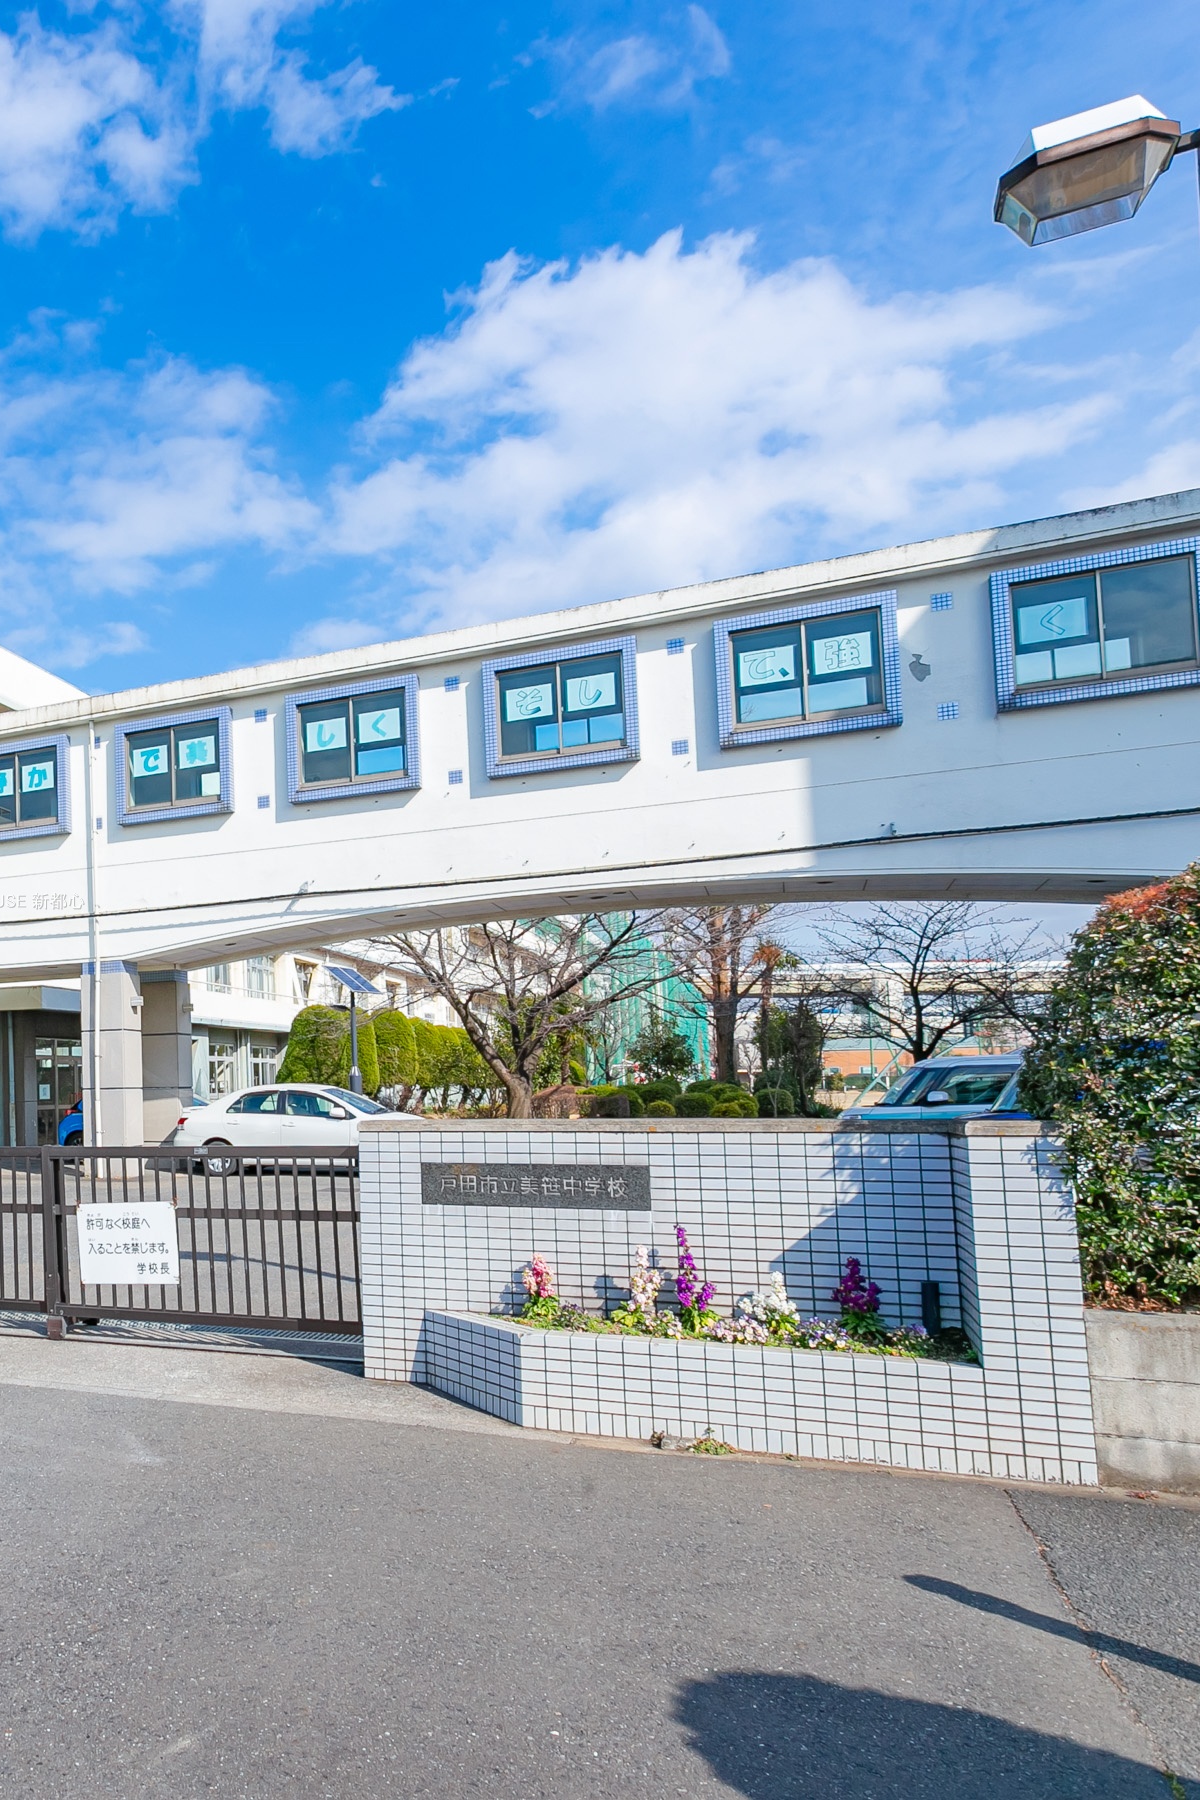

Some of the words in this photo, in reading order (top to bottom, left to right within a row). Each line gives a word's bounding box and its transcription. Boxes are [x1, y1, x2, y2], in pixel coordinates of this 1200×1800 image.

[440, 1174, 629, 1198] 戸田市立美笹中学校
[86, 1217, 151, 1230] 許可なく校庭へ
[88, 1242, 169, 1255] 入ることを禁じます。
[136, 1262, 170, 1275] 学校長
